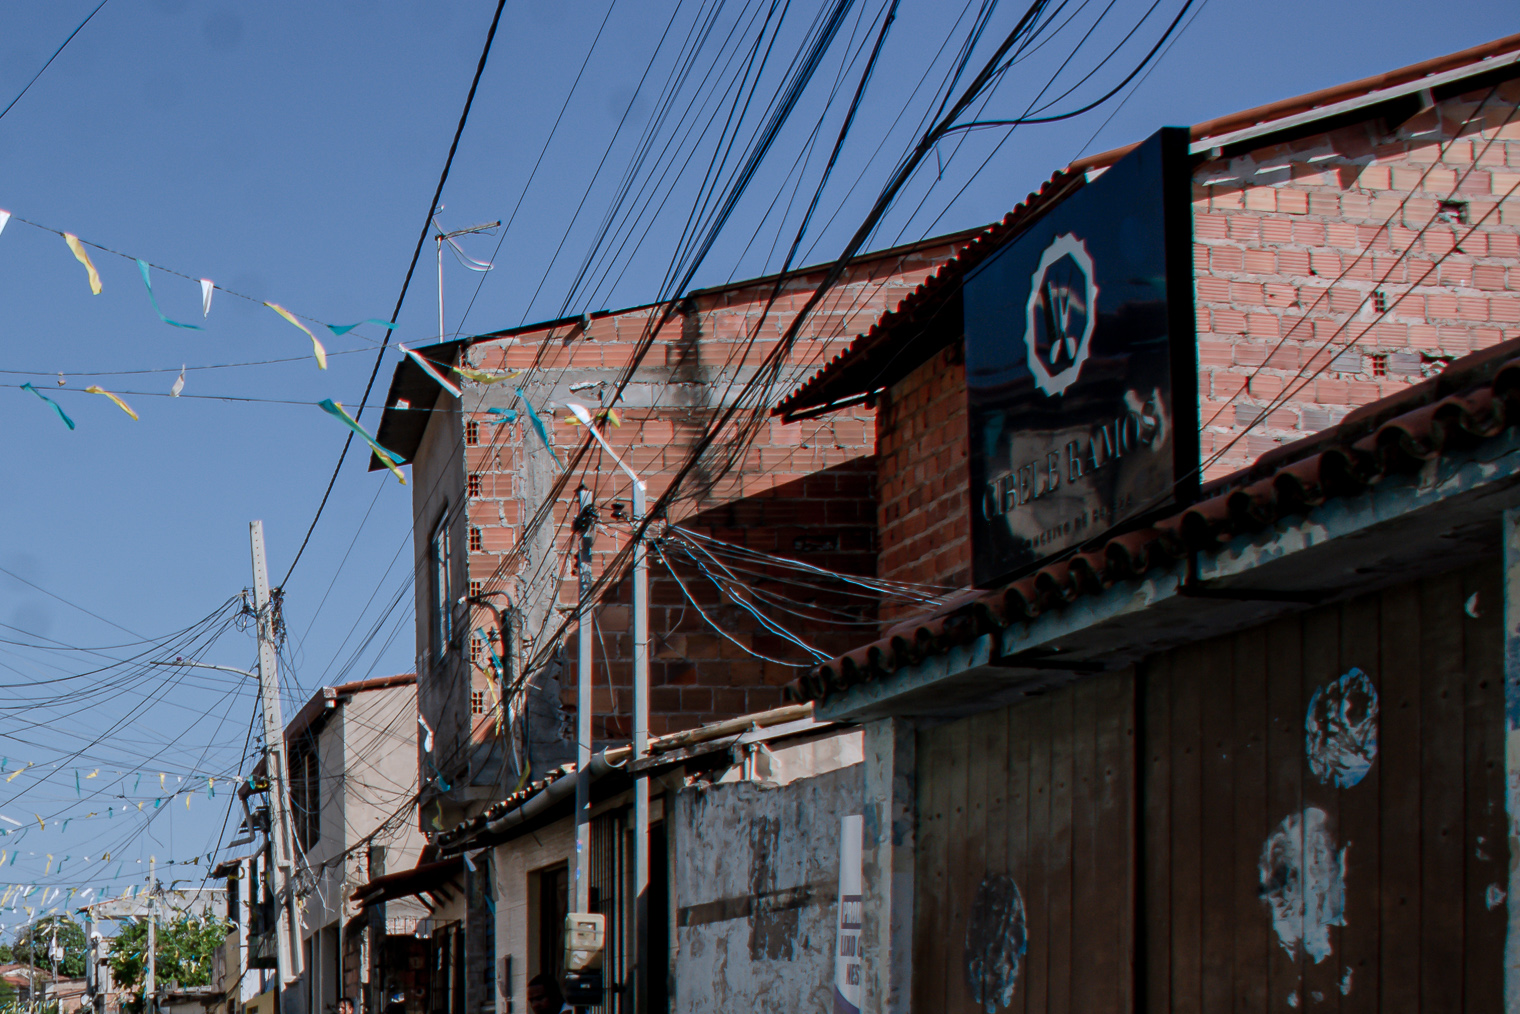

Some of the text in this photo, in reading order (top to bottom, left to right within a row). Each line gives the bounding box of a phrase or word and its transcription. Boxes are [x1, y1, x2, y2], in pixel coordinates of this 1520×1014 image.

[982, 400, 1158, 522] CIBELE RAMOS
[1018, 521, 1071, 551] ONCEITO
